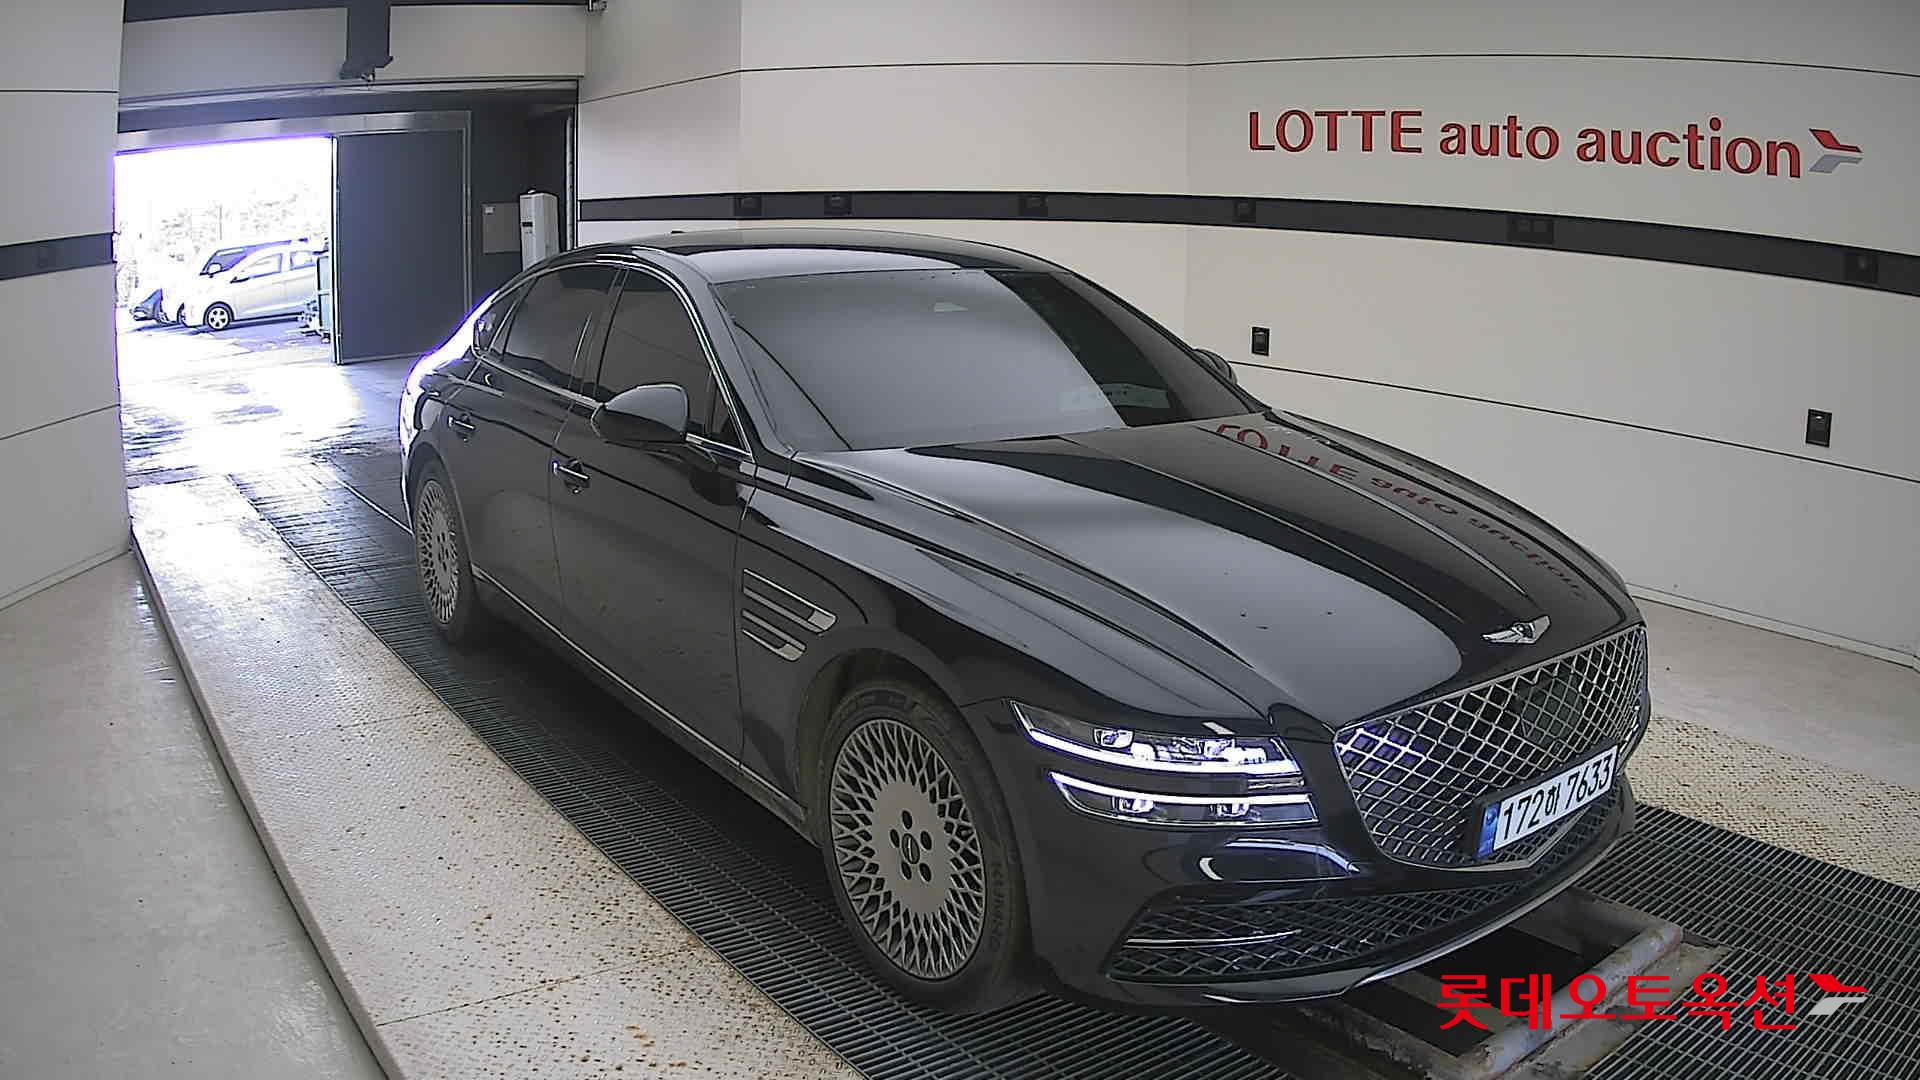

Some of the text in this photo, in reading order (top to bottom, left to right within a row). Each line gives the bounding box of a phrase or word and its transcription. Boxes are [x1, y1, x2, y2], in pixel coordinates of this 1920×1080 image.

[1249, 111, 1801, 178] LOTTE auto auction
[1503, 752, 1613, 840] 172하 7633
